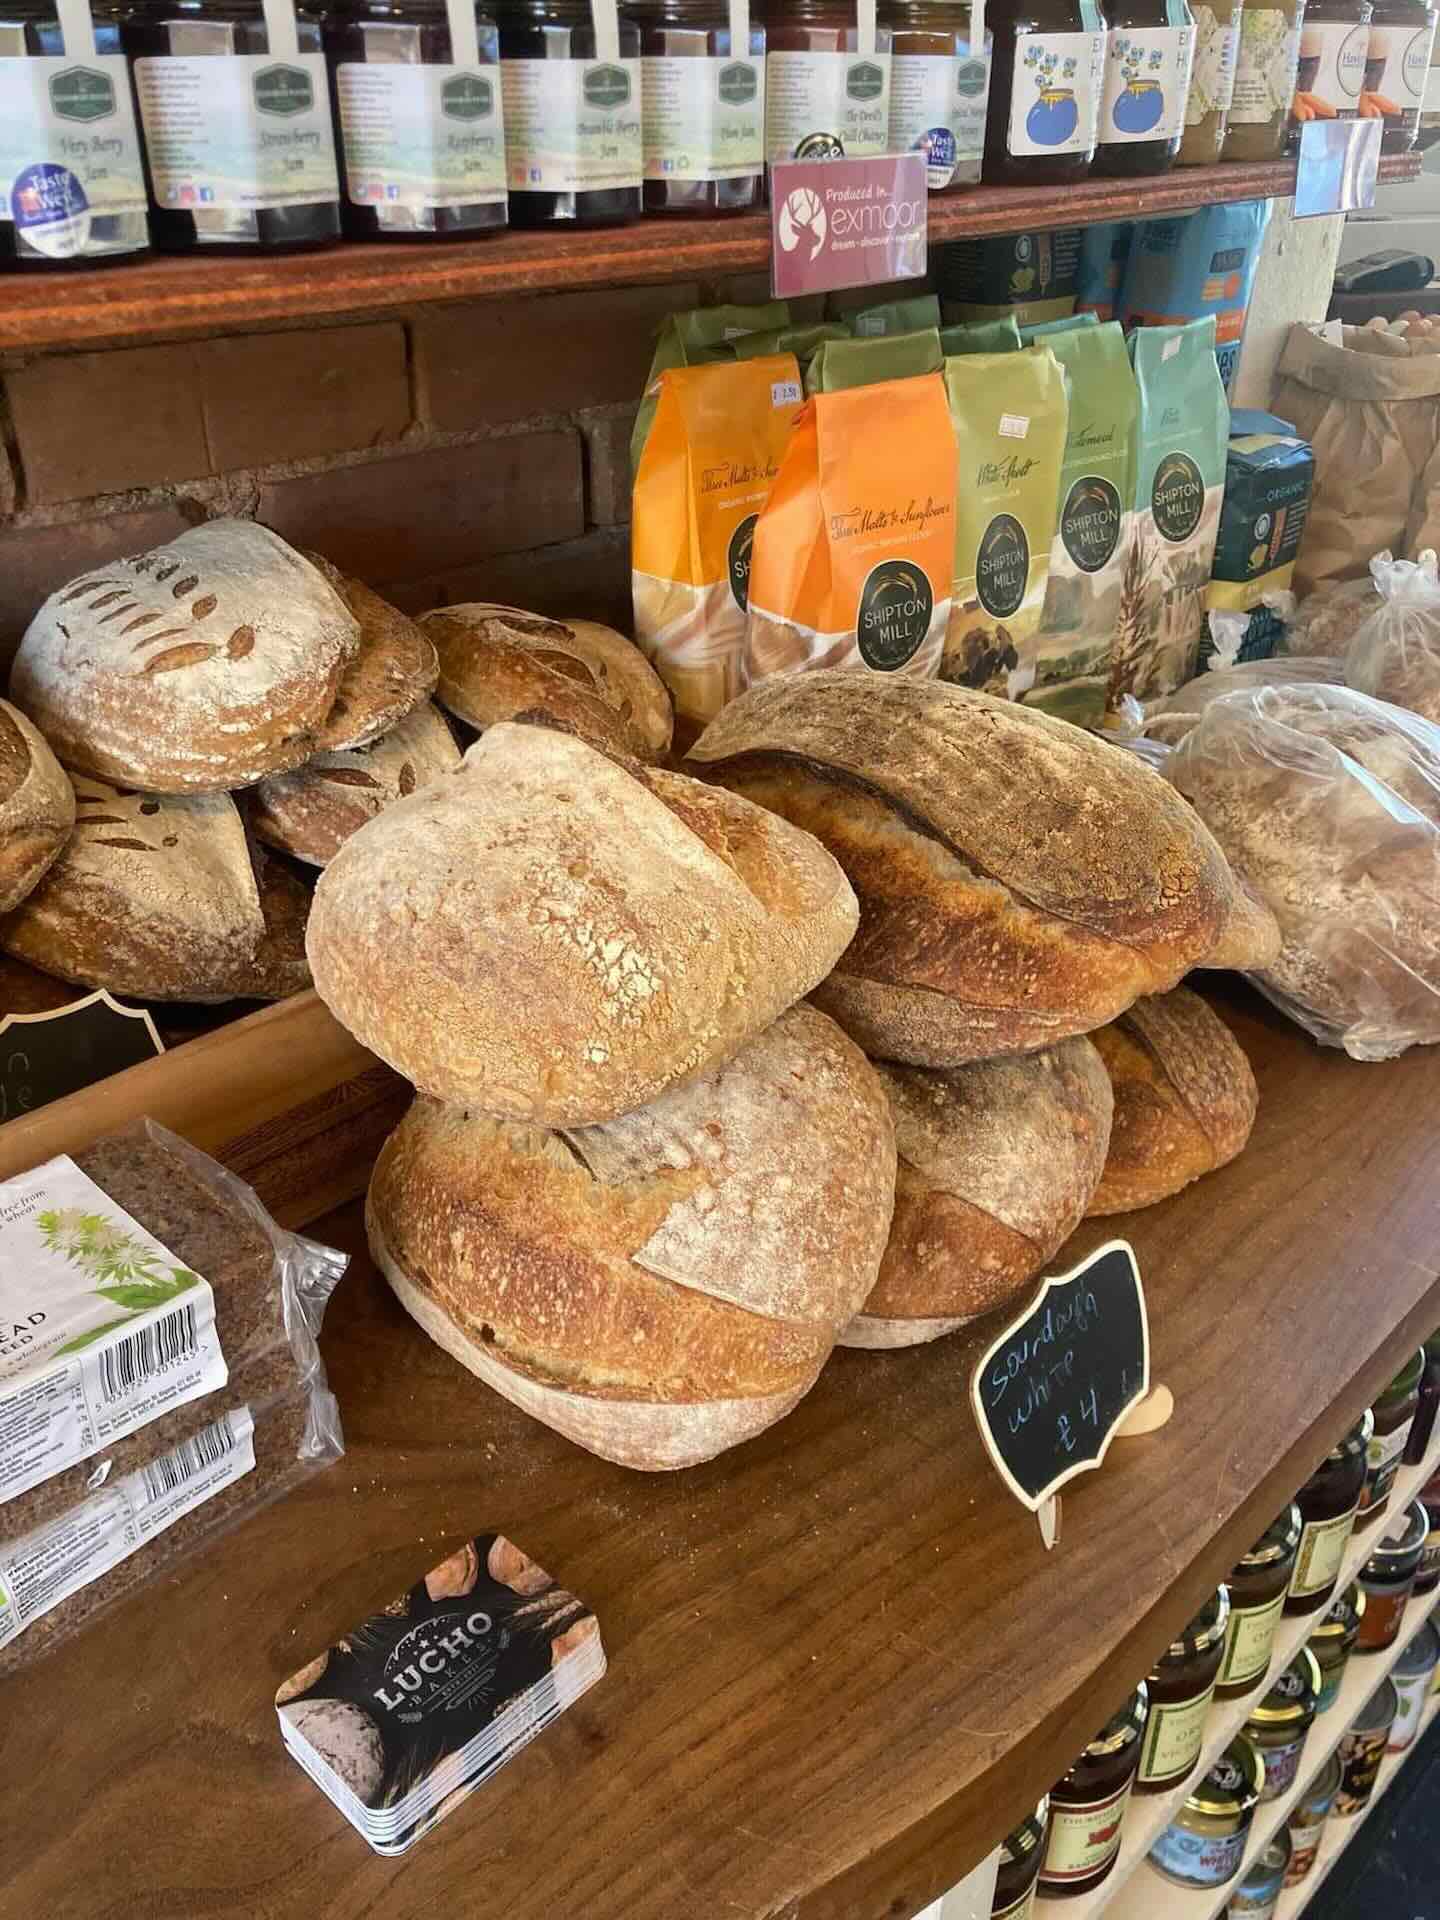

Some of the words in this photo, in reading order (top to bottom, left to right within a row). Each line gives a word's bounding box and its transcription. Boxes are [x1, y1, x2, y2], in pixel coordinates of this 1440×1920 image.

[825, 184, 874, 202] Produced
[830, 200, 921, 235] exmoor
[1154, 480, 1200, 507] SHIPTON
[1064, 508, 1119, 535] SHIPTON
[1166, 502, 1191, 518] MILL
[1080, 529, 1108, 547] MILL
[980, 551, 1025, 576] SHIPTON
[993, 574, 1017, 592] MILL
[863, 597, 928, 630] SHIPTON
[878, 623, 913, 646] MILL
[20, 1190, 46, 1208] from
[5, 1203, 36, 1223] wheat
[373, 1611, 493, 1712] LUCHO
